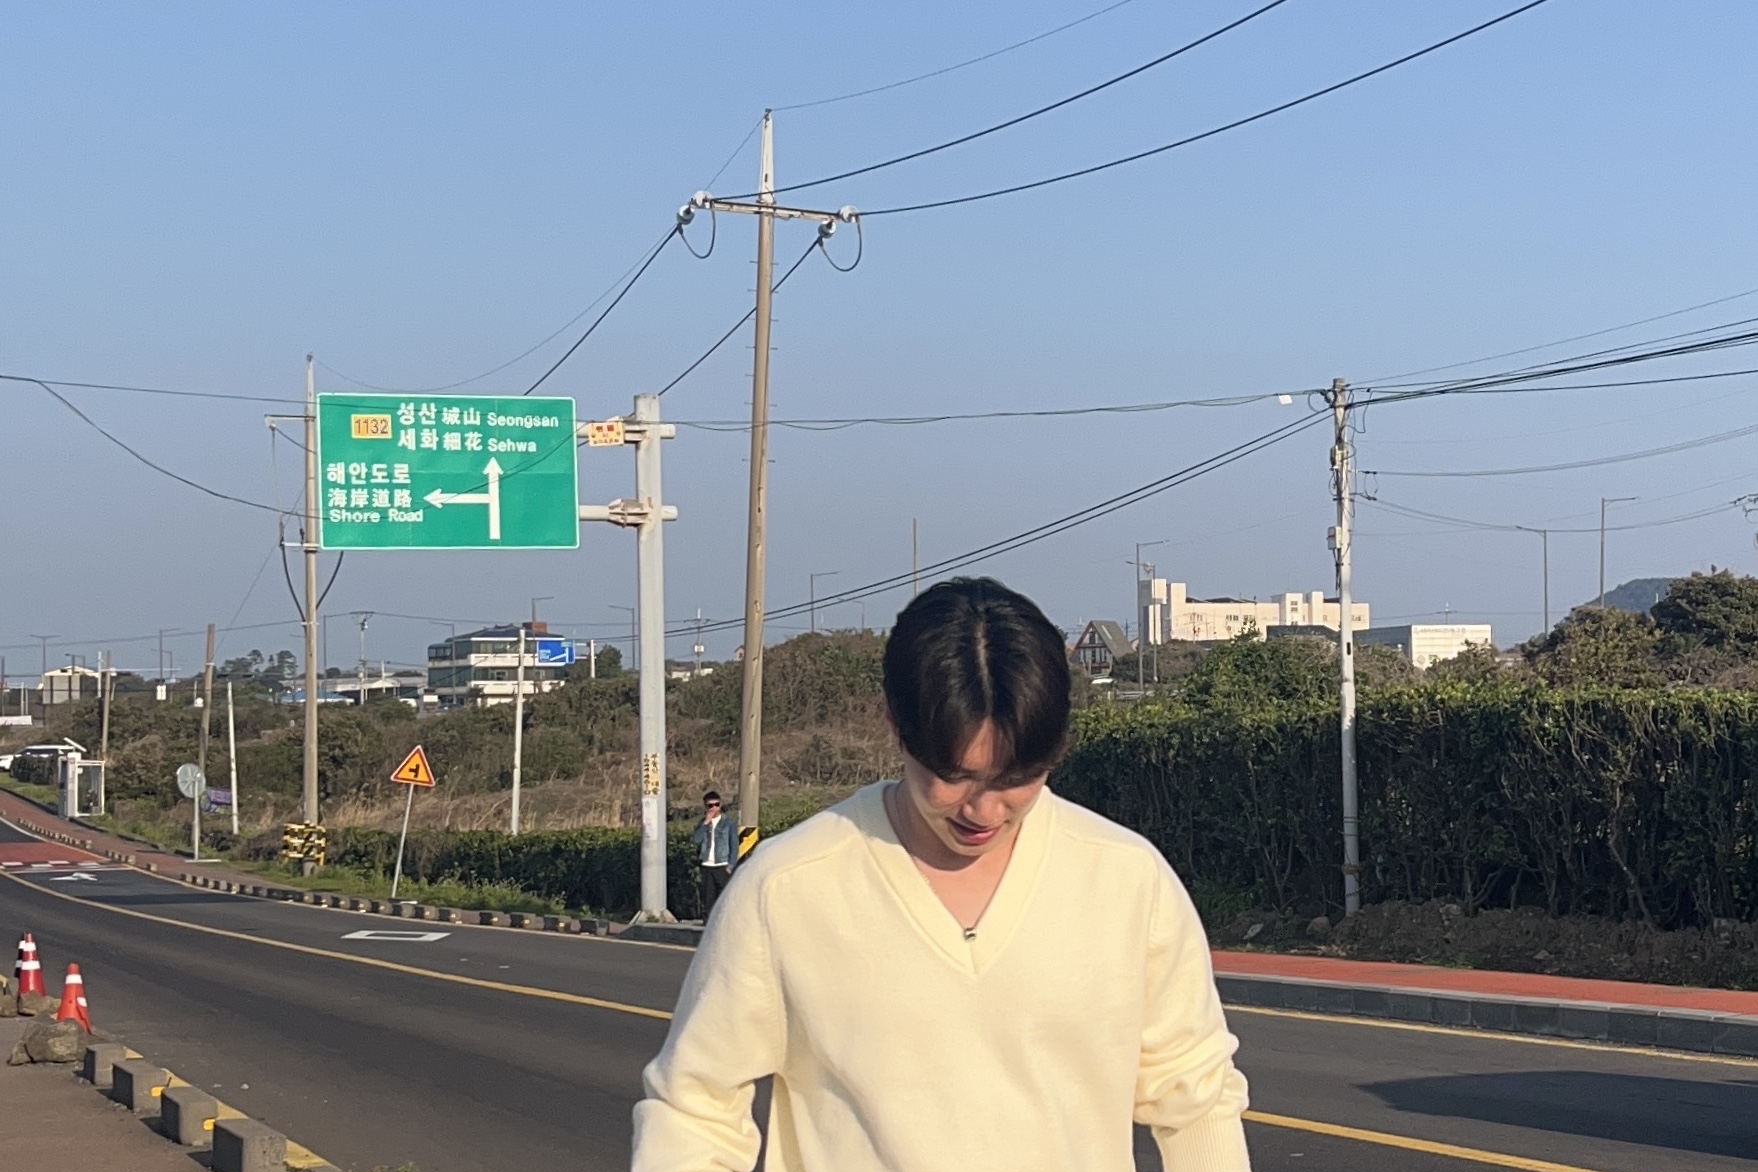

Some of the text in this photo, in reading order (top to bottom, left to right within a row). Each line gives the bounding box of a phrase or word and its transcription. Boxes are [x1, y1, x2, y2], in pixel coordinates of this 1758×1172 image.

[397, 402, 559, 428] 성산 城山 Seongsan
[355, 418, 389, 434] 1132
[398, 428, 537, 452] 세화 細花 Sehwa
[327, 462, 411, 485] 해안도로
[328, 488, 412, 507] 海岸道路
[329, 508, 423, 522] Shore Road
